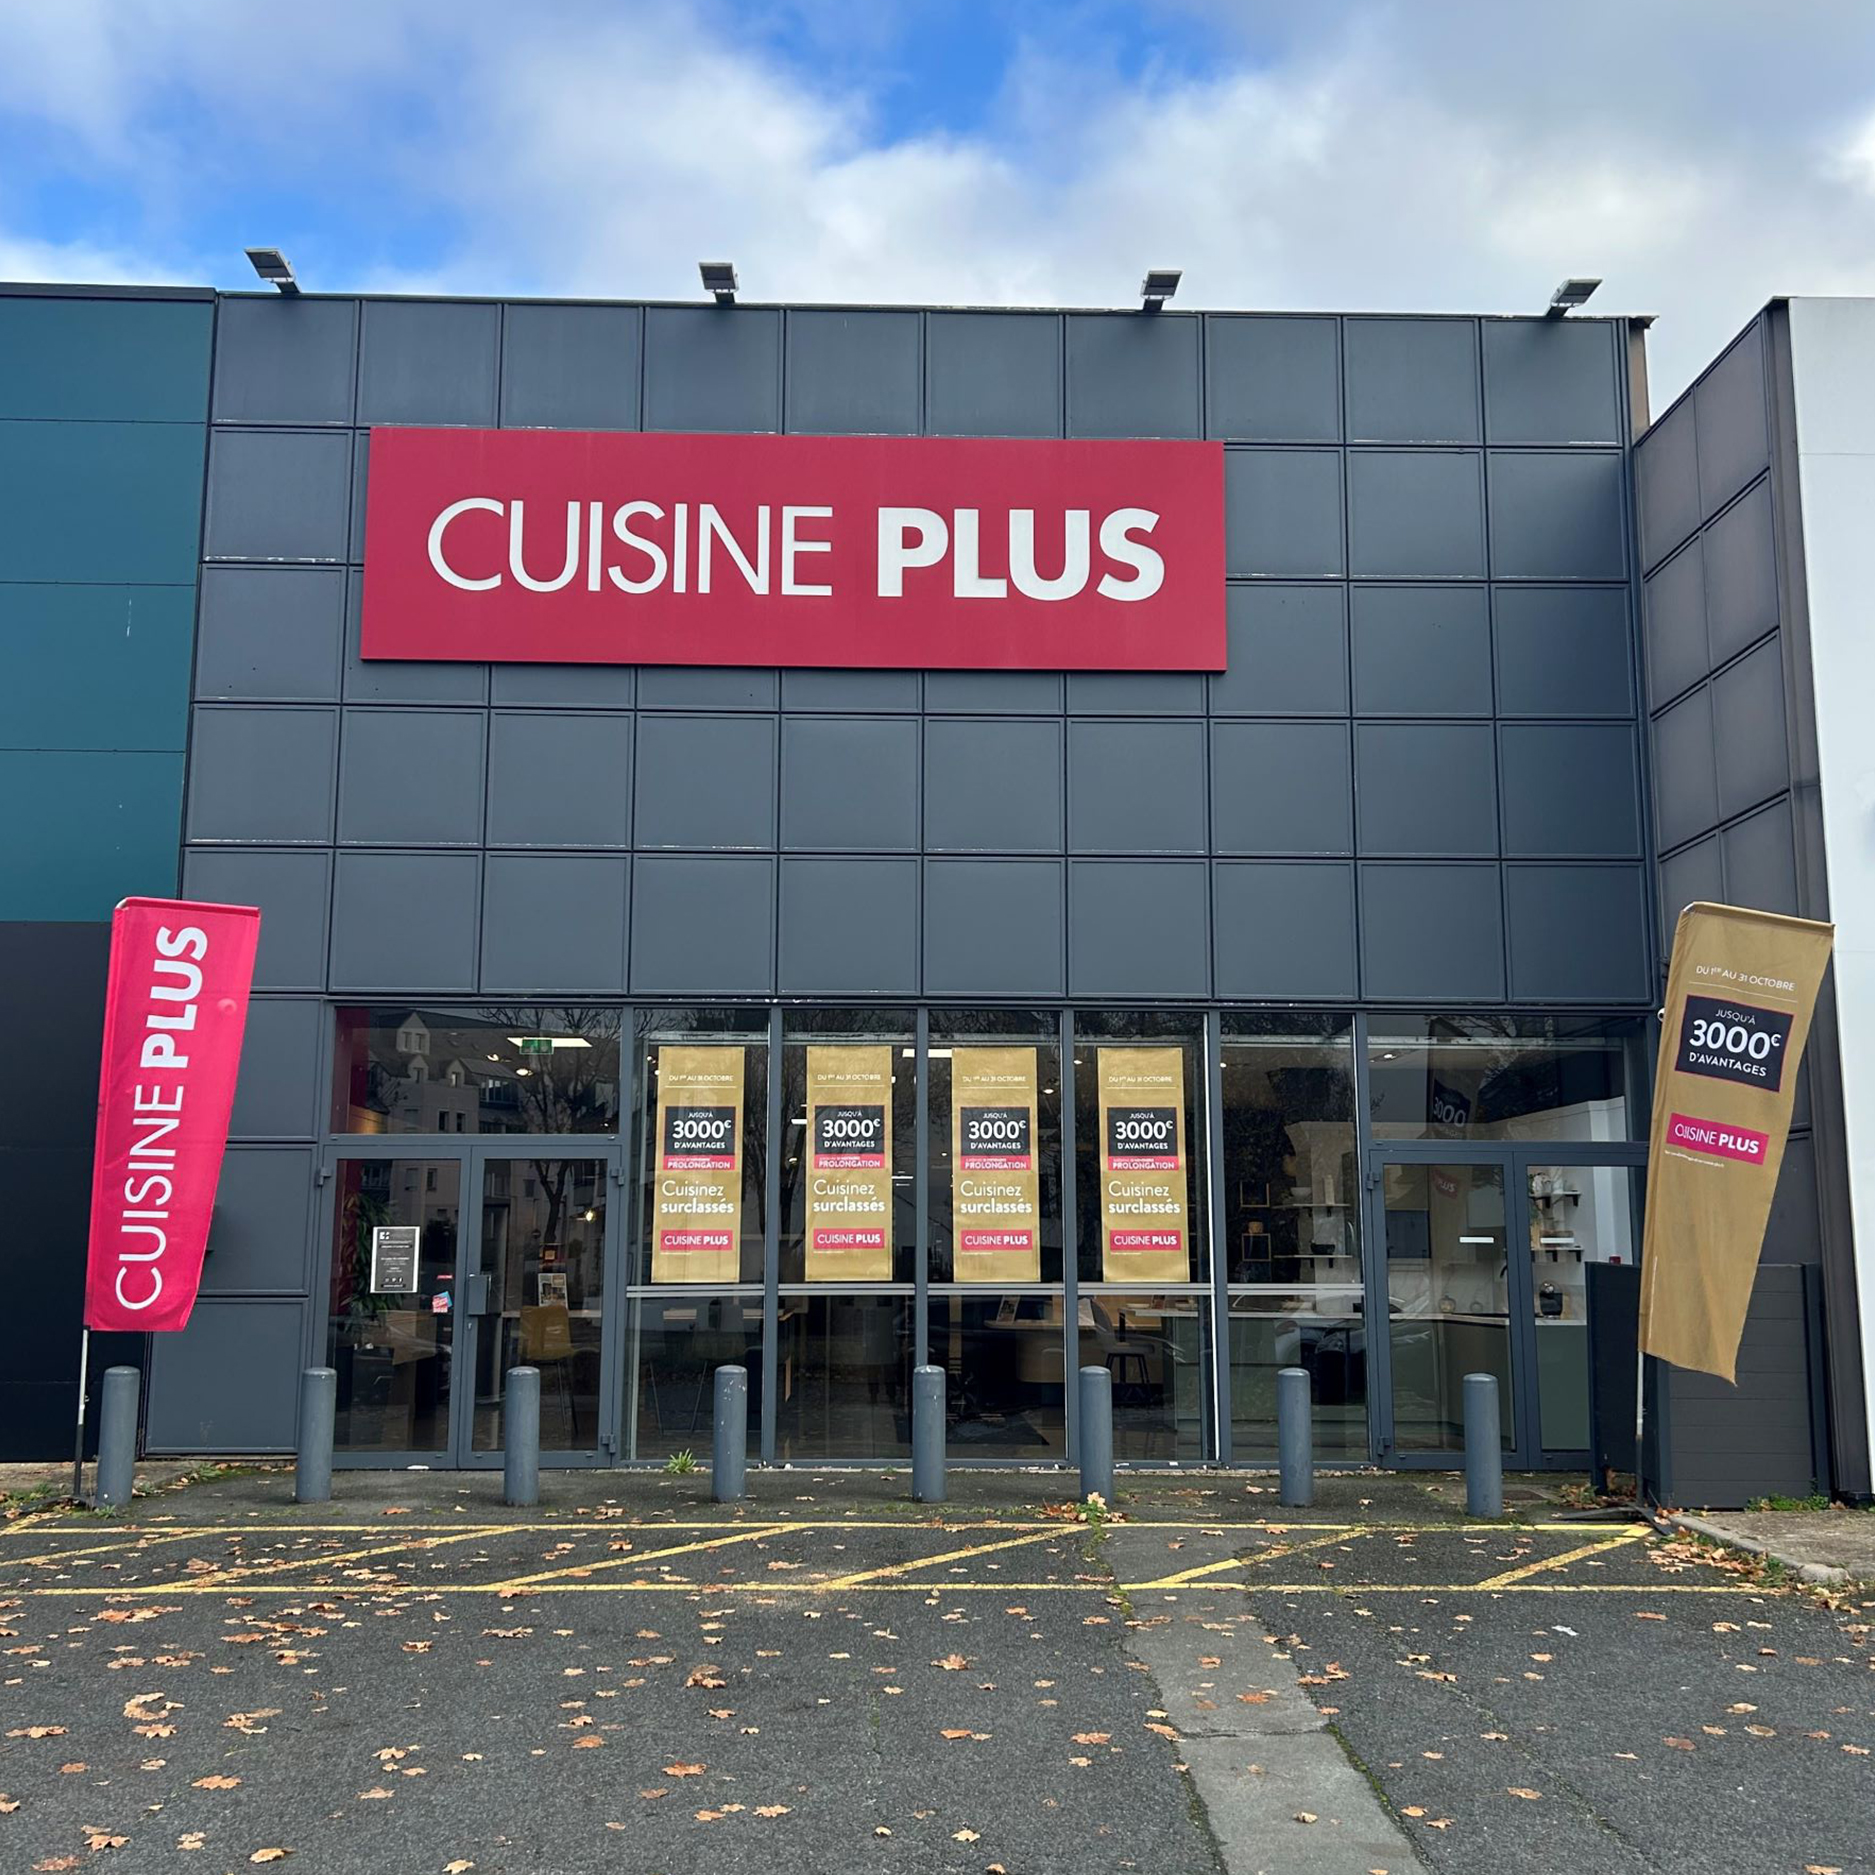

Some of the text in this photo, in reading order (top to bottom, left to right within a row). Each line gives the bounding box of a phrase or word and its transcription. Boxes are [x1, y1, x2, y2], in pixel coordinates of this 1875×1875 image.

[427, 497, 1165, 601] CUISINE PLUS
[1696, 965, 1709, 975] DU
[1722, 969, 1737, 980] AU
[1738, 973, 1748, 982] 31
[1749, 975, 1795, 992] OCTOBRE
[1715, 1006, 1756, 1025] JUSQU'À
[1689, 1019, 1782, 1060] 3000€
[1689, 1051, 1767, 1077] D'AVANTAGES
[115, 925, 208, 1310] CUISINE PLUS
[672, 1120, 732, 1139] 3000€
[822, 1119, 880, 1138] 3000€
[968, 1120, 1026, 1139] 3000€
[1115, 1120, 1173, 1139] 3000€
[1718, 1133, 1760, 1154] PLUS
[662, 1180, 724, 1196] Cuisinez
[813, 1180, 875, 1195] Cuisinez
[960, 1180, 1022, 1196] Cuisinez
[1108, 1180, 1170, 1196] Cuisinez
[661, 1199, 734, 1214] surclassés
[813, 1198, 885, 1212] surclassés
[960, 1198, 1032, 1214] surclassés
[1108, 1198, 1180, 1214] surclassés
[664, 1235, 728, 1245] CUISINE PLUS
[817, 1234, 880, 1244] CUISINE PLUS
[965, 1235, 1028, 1245] CUISINE PLUS
[1114, 1235, 1177, 1245] CUISINE PLUS
